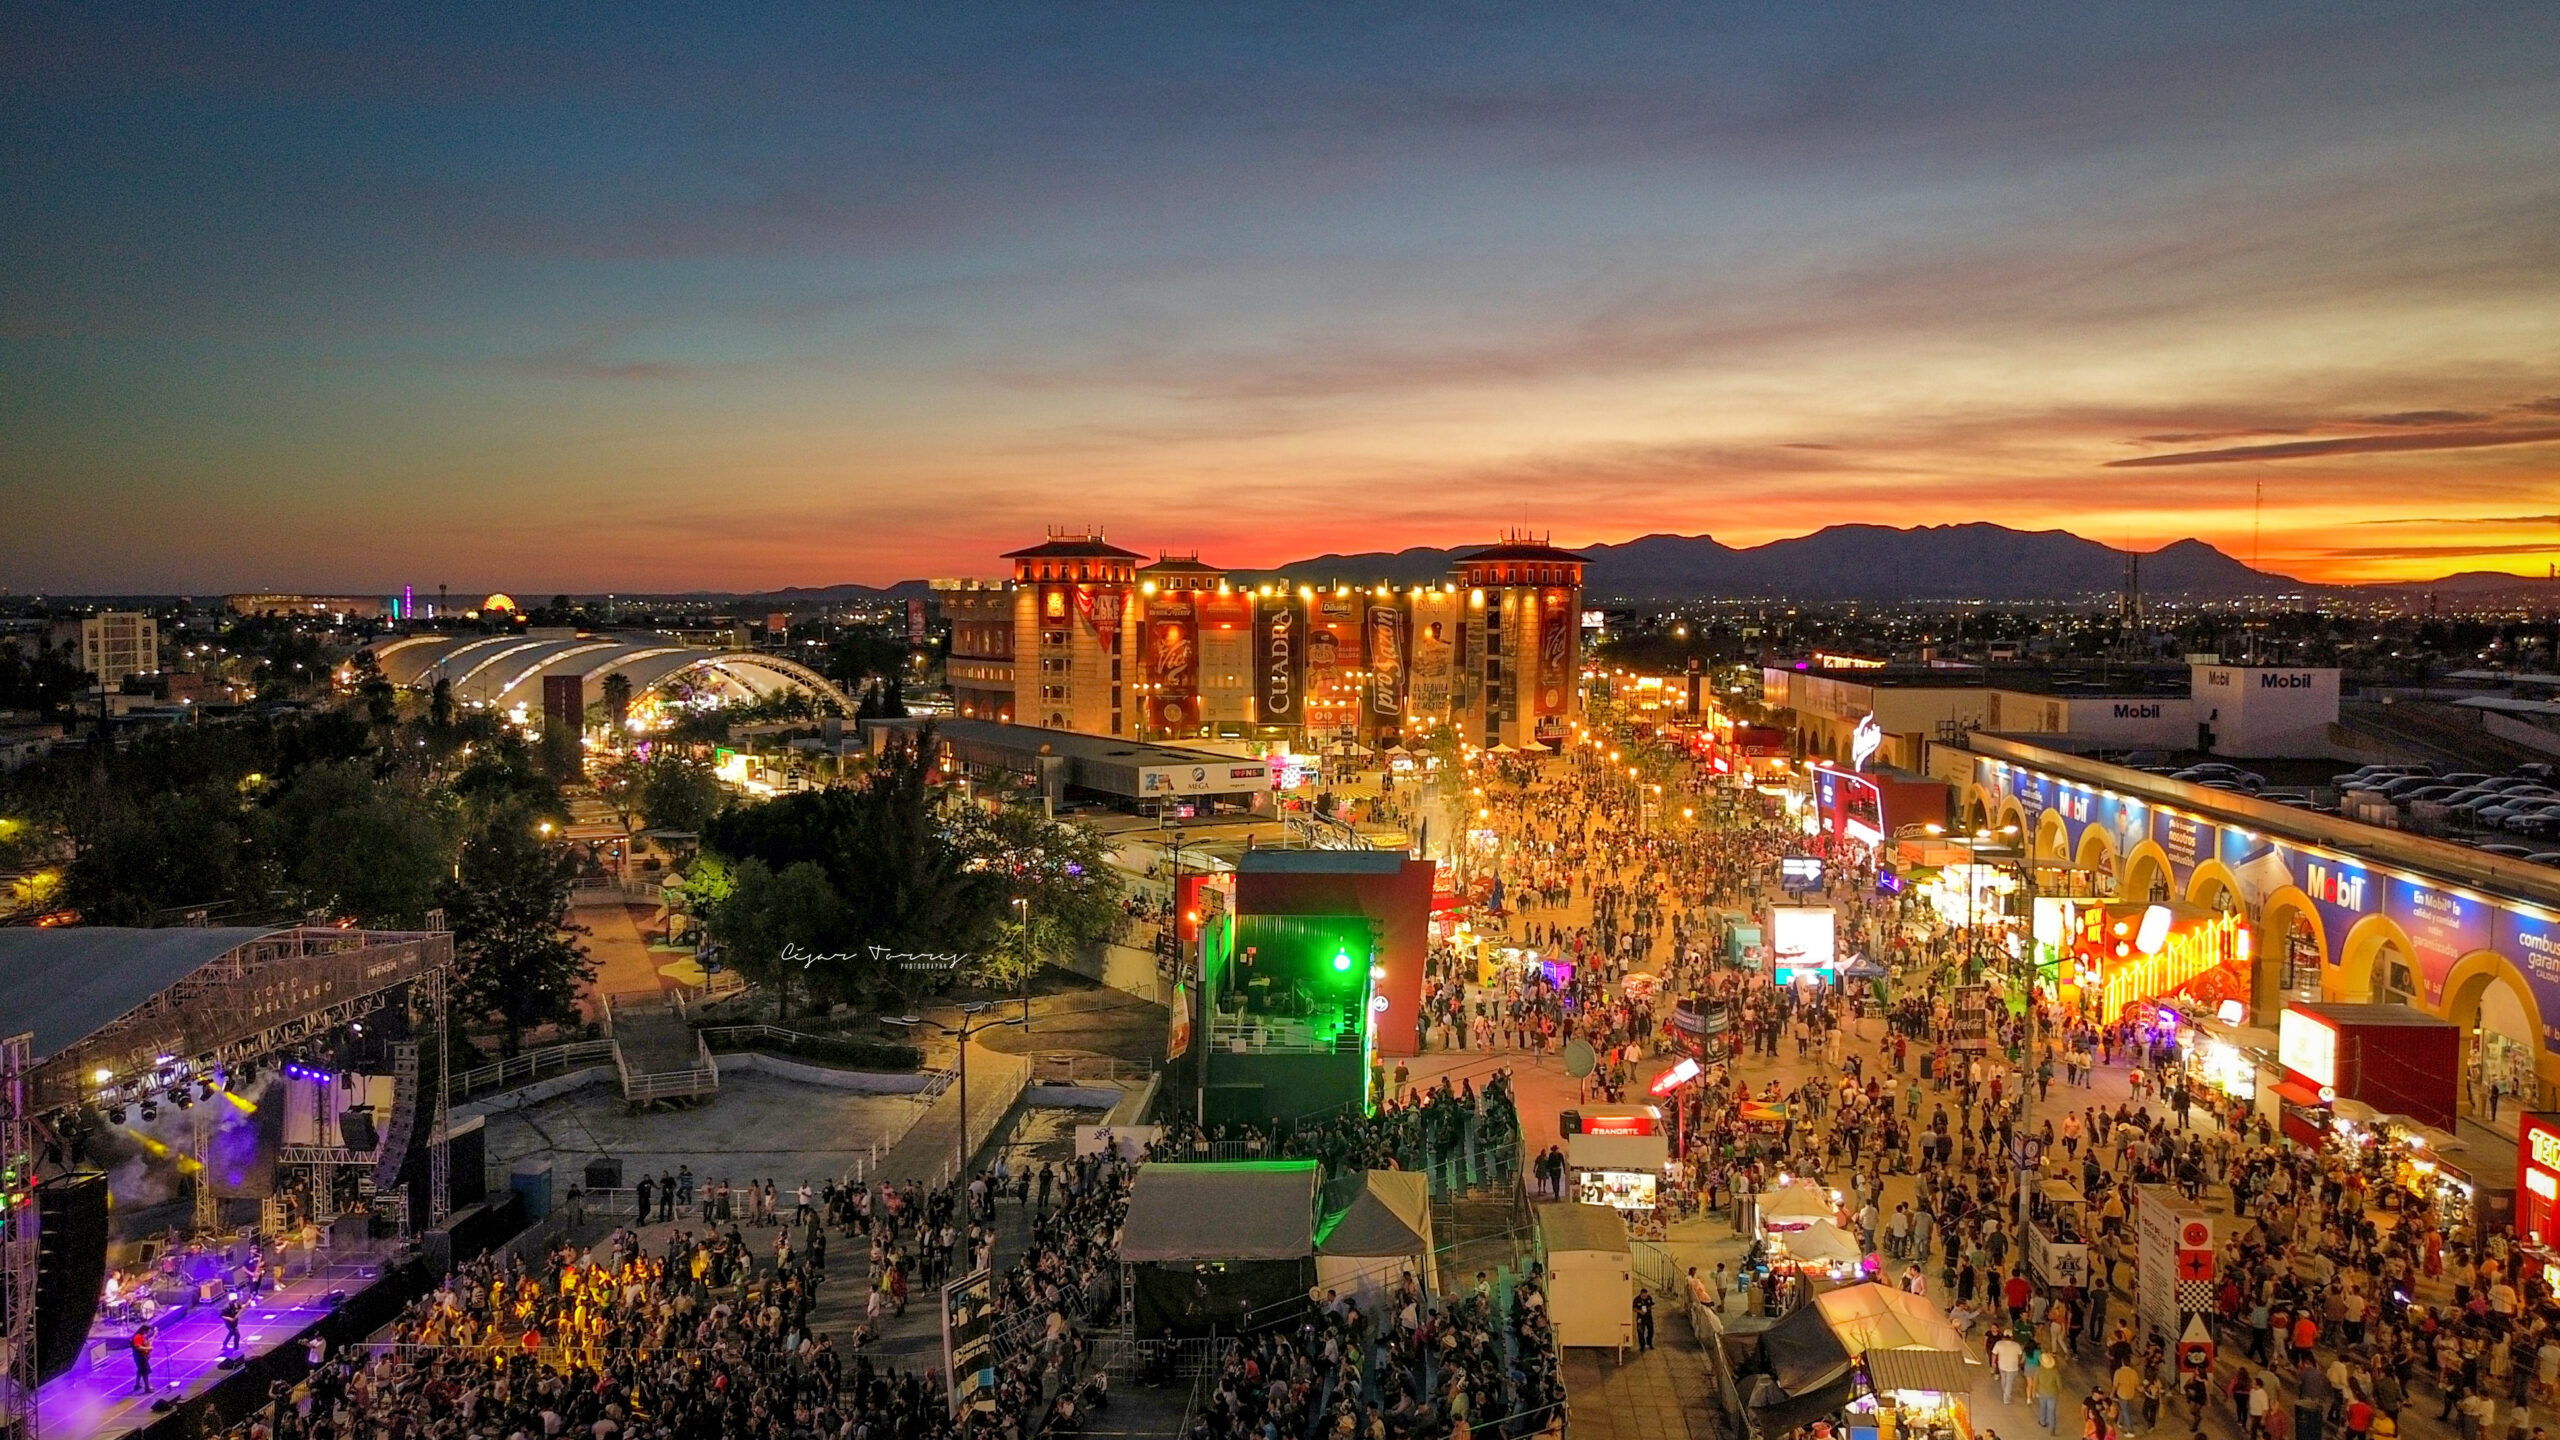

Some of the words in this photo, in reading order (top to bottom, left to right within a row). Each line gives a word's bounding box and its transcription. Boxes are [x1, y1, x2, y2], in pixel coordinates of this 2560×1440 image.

[1268, 606, 1293, 714] CUADRA
[2208, 671, 2230, 687] Mobil
[2261, 673, 2312, 689] Mobil
[2113, 704, 2160, 719] Mobil
[1187, 782, 1210, 790] MEGA
[2059, 791, 2090, 823] Mobil
[2307, 863, 2366, 912] Mobil
[2413, 889, 2425, 905] En
[2452, 900, 2462, 916] la
[253, 976, 300, 1001] FORO
[254, 999, 282, 1017] DEL
[292, 980, 333, 1004] LAGO
[1599, 1127, 1640, 1136] BANORTE
[962, 1334, 990, 1353] CEMENTO
